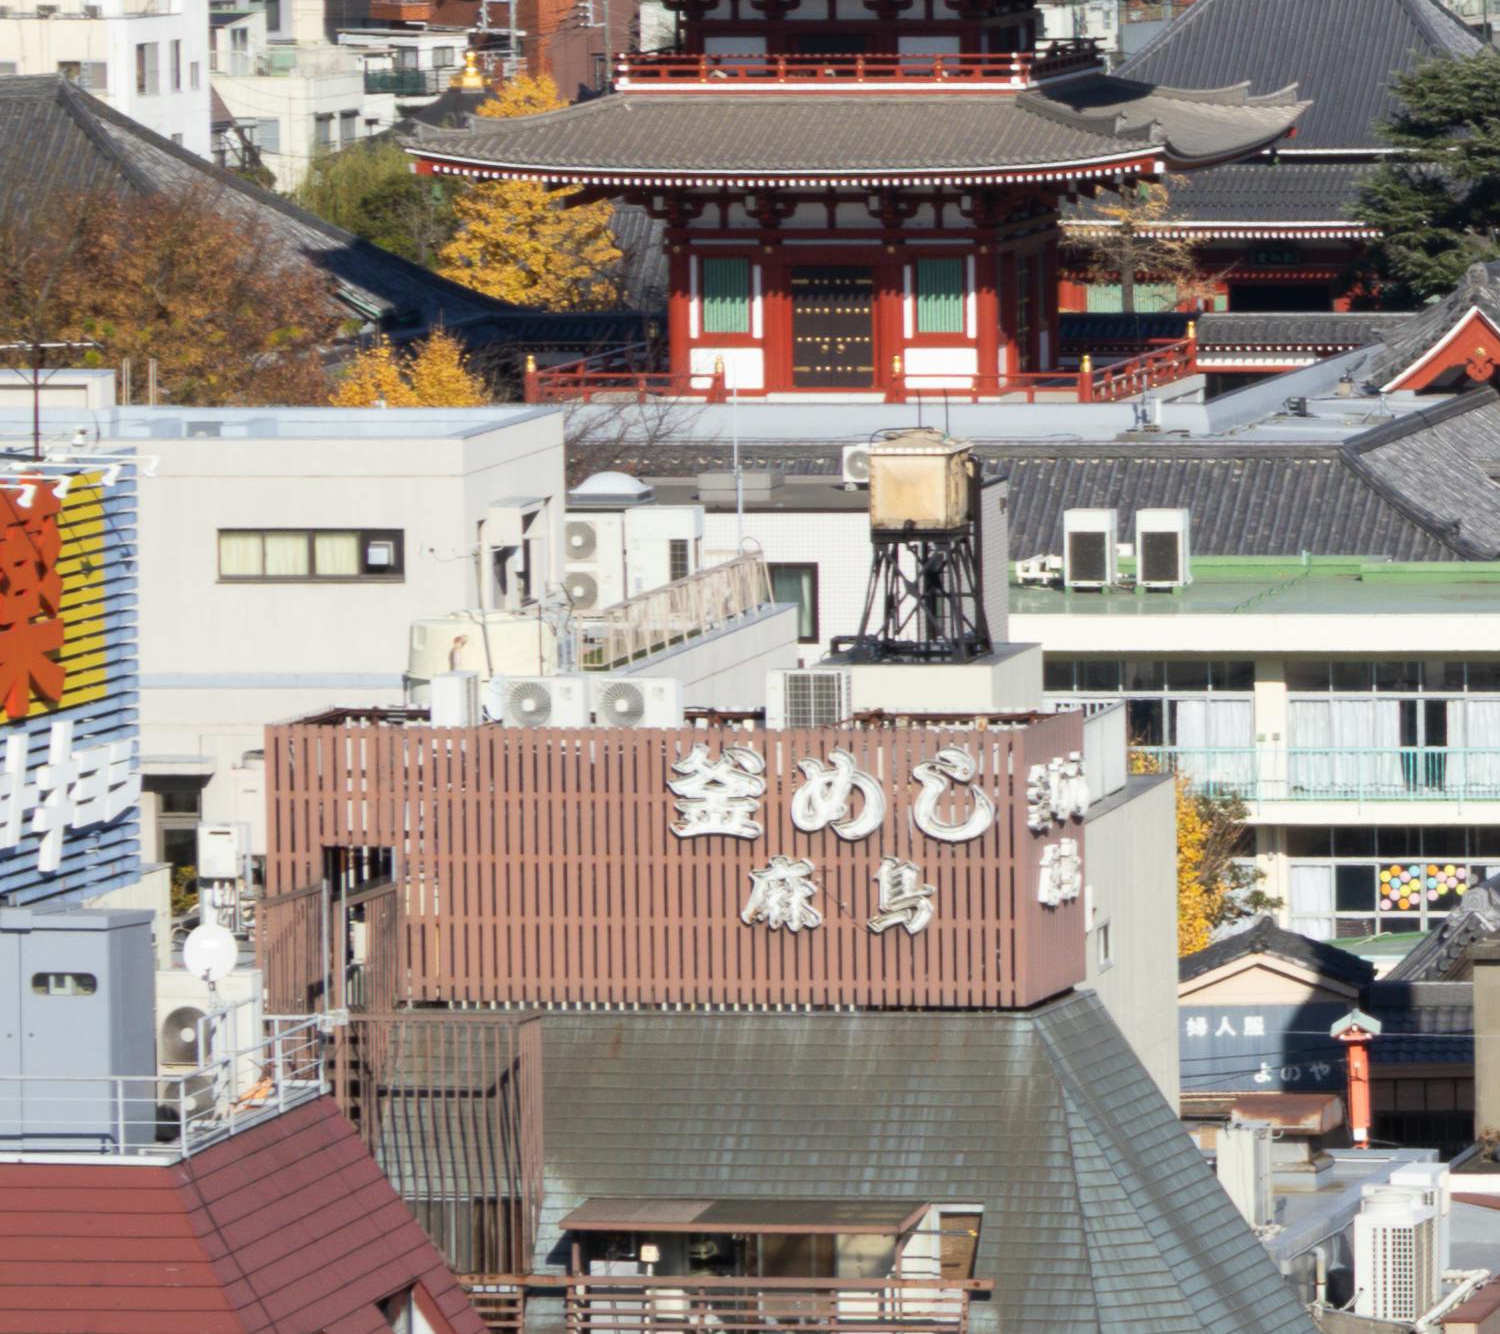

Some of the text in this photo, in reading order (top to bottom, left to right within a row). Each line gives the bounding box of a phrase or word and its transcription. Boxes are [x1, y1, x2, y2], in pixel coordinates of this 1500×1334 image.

[667, 742, 995, 842] 釜めし
[1186, 1015, 1265, 1037] 婦人服
[1253, 1061, 1331, 1083] よのや
